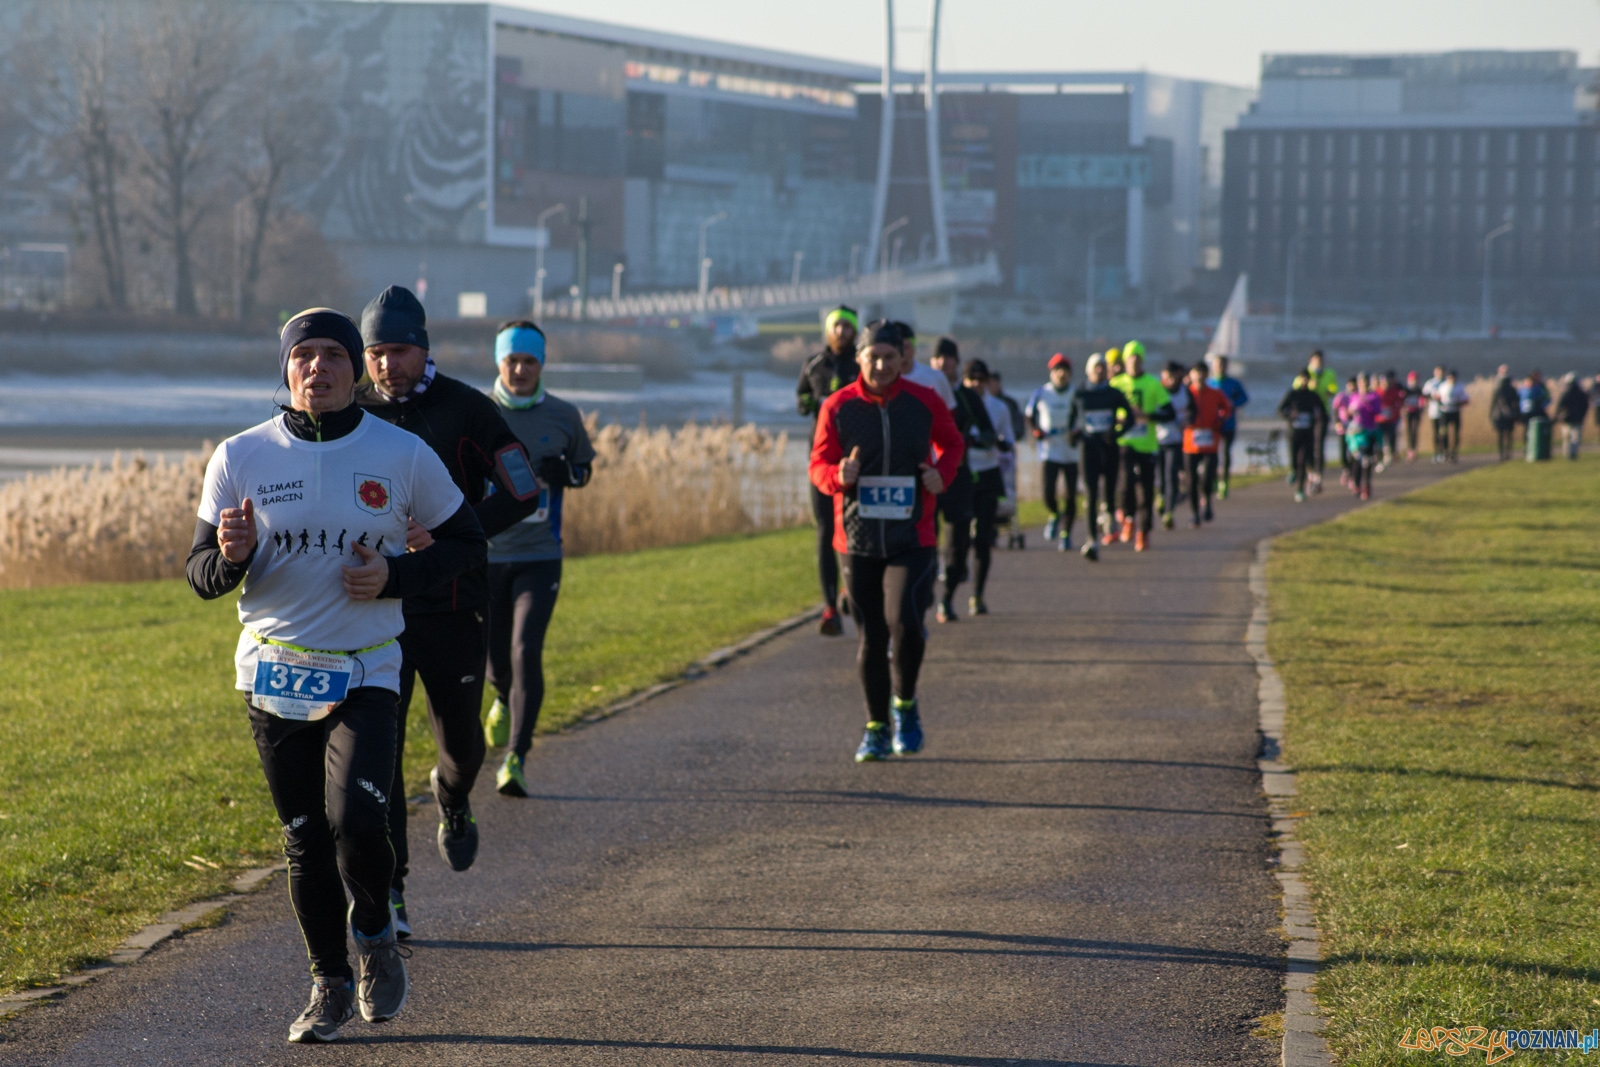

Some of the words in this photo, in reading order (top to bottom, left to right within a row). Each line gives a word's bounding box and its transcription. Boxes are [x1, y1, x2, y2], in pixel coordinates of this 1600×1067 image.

[257, 480, 303, 495] ŚLIMAKI
[261, 493, 303, 506] BARCIN
[869, 487, 906, 503] 114
[279, 657, 311, 666] RYSZARDA
[301, 653, 346, 664] SYLWESTROWY
[270, 664, 331, 695] 373
[280, 690, 314, 699] KRYSTIAN
